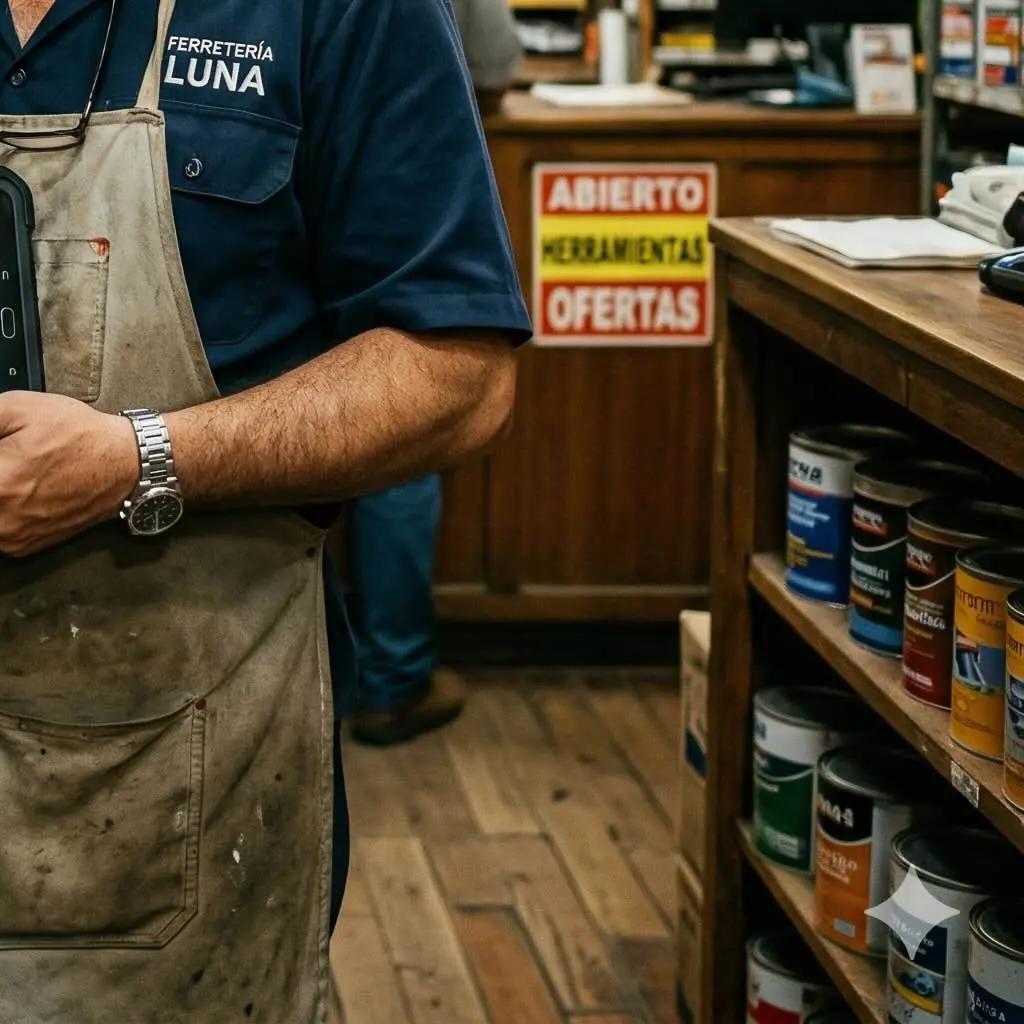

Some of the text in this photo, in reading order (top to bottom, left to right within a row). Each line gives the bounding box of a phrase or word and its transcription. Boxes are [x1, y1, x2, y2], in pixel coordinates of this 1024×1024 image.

[167, 36, 274, 61] FERRETERÍA
[164, 55, 265, 96] LUNA
[549, 176, 705, 211] ABIERTO
[543, 236, 704, 265] HERRAMIENTAS
[548, 286, 701, 332] OFERTAS
